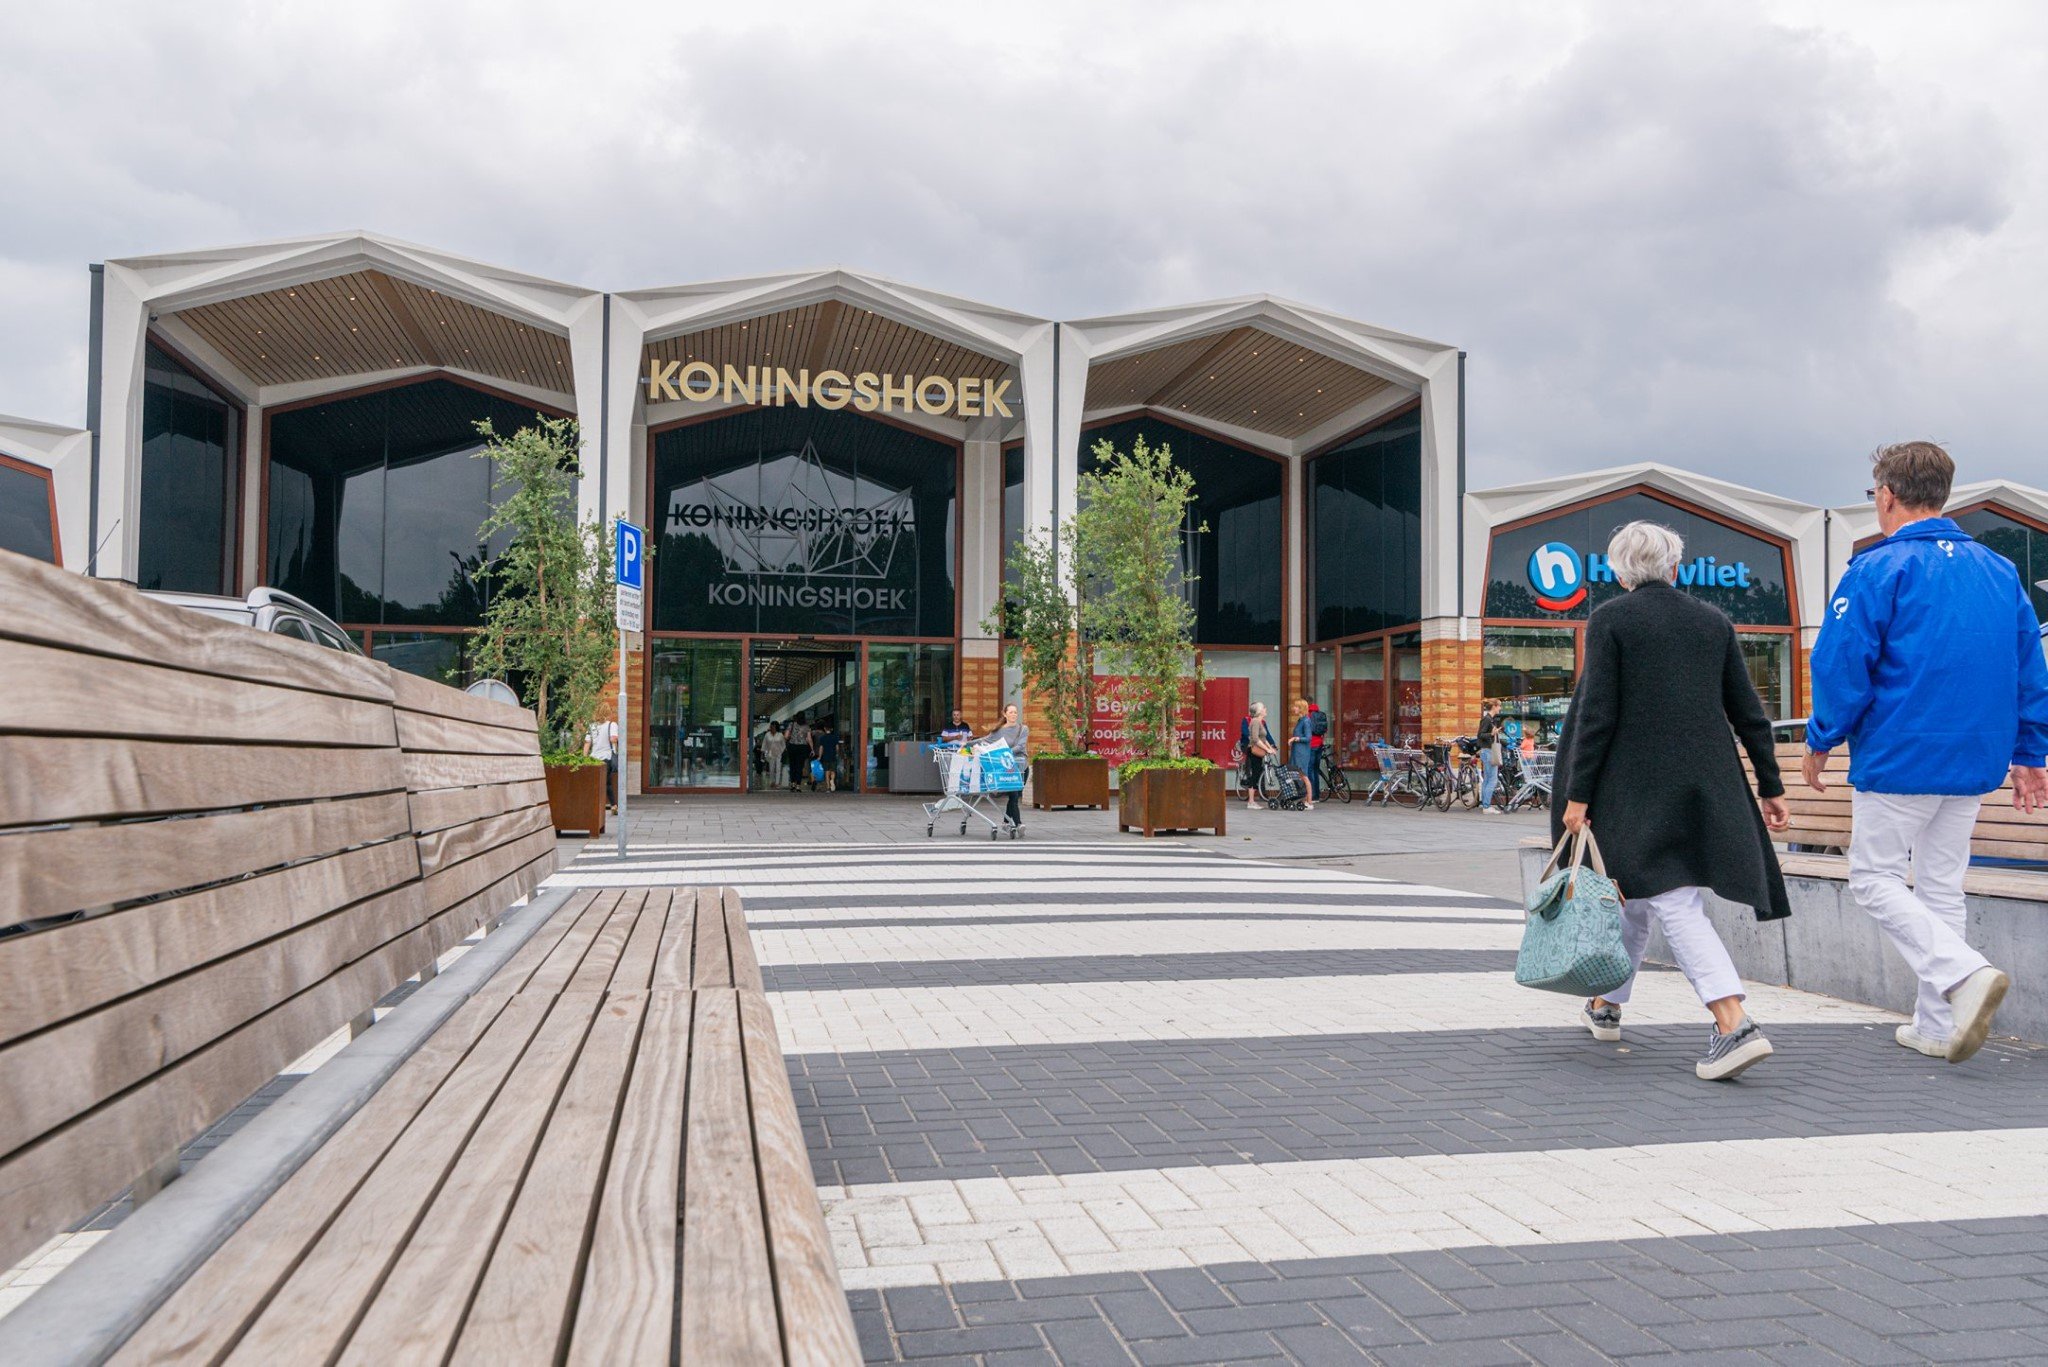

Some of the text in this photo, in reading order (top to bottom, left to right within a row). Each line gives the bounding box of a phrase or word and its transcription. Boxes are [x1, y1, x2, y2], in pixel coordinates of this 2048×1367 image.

[650, 359, 1013, 418] KONINGSHOEK
[624, 530, 637, 578] P
[1586, 553, 1751, 590] Hvliet
[708, 582, 907, 611] KONINGSHOEK
